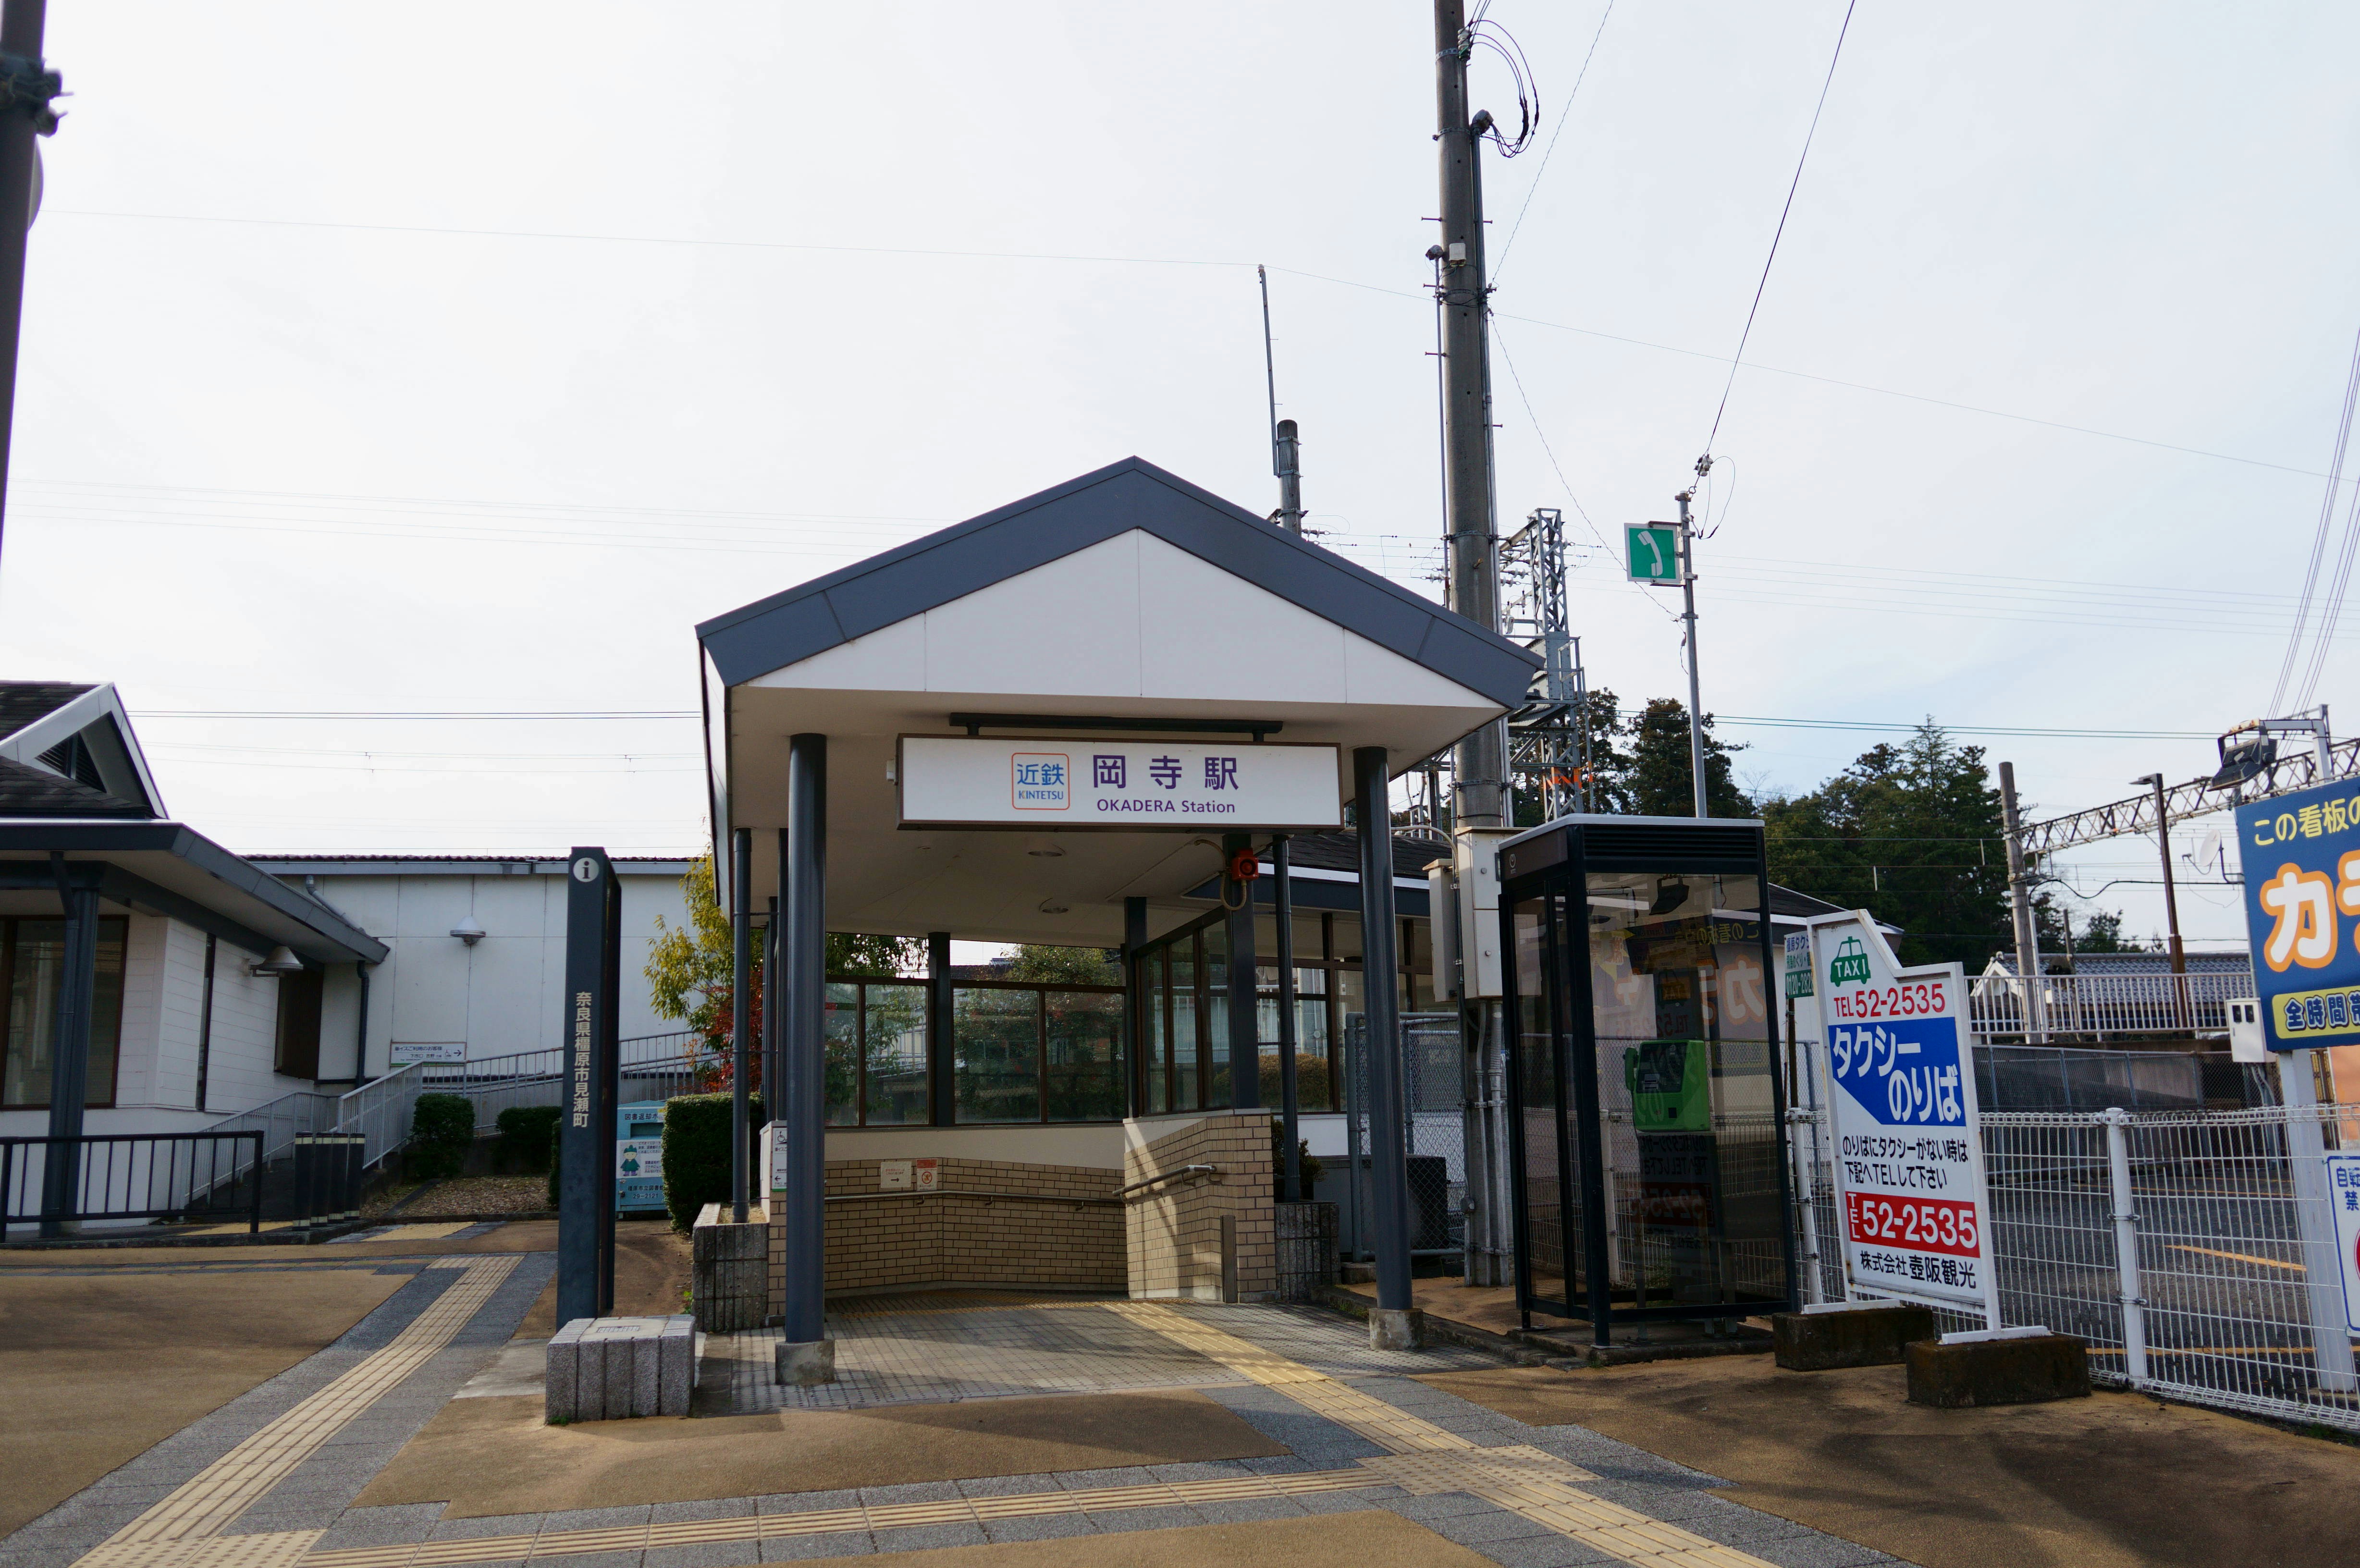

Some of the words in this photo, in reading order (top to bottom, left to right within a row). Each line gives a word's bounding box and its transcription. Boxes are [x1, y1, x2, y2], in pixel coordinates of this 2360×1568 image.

[1017, 762, 1065, 786] 近鉄
[1093, 755, 1239, 790] 岡寺駅
[1018, 789, 1064, 800] KINTETSU
[1097, 799, 1175, 813] OKADERA
[1182, 799, 1235, 813] Station
[2261, 850, 2360, 970] カ
[1834, 959, 1866, 978] TAXI
[573, 991, 592, 1128] 奈良県橿原市見瀬町
[1833, 1025, 1921, 1078] タクシー
[1888, 1064, 1961, 1122] のりば
[1843, 1136, 1968, 1163] のりばにタクシーがない時は
[1844, 1161, 1948, 1189] 下記へTELして下さい
[1848, 1193, 1860, 1239] TEL
[2344, 1190, 2360, 1211] 禁
[1863, 1200, 1977, 1249] 52-2535
